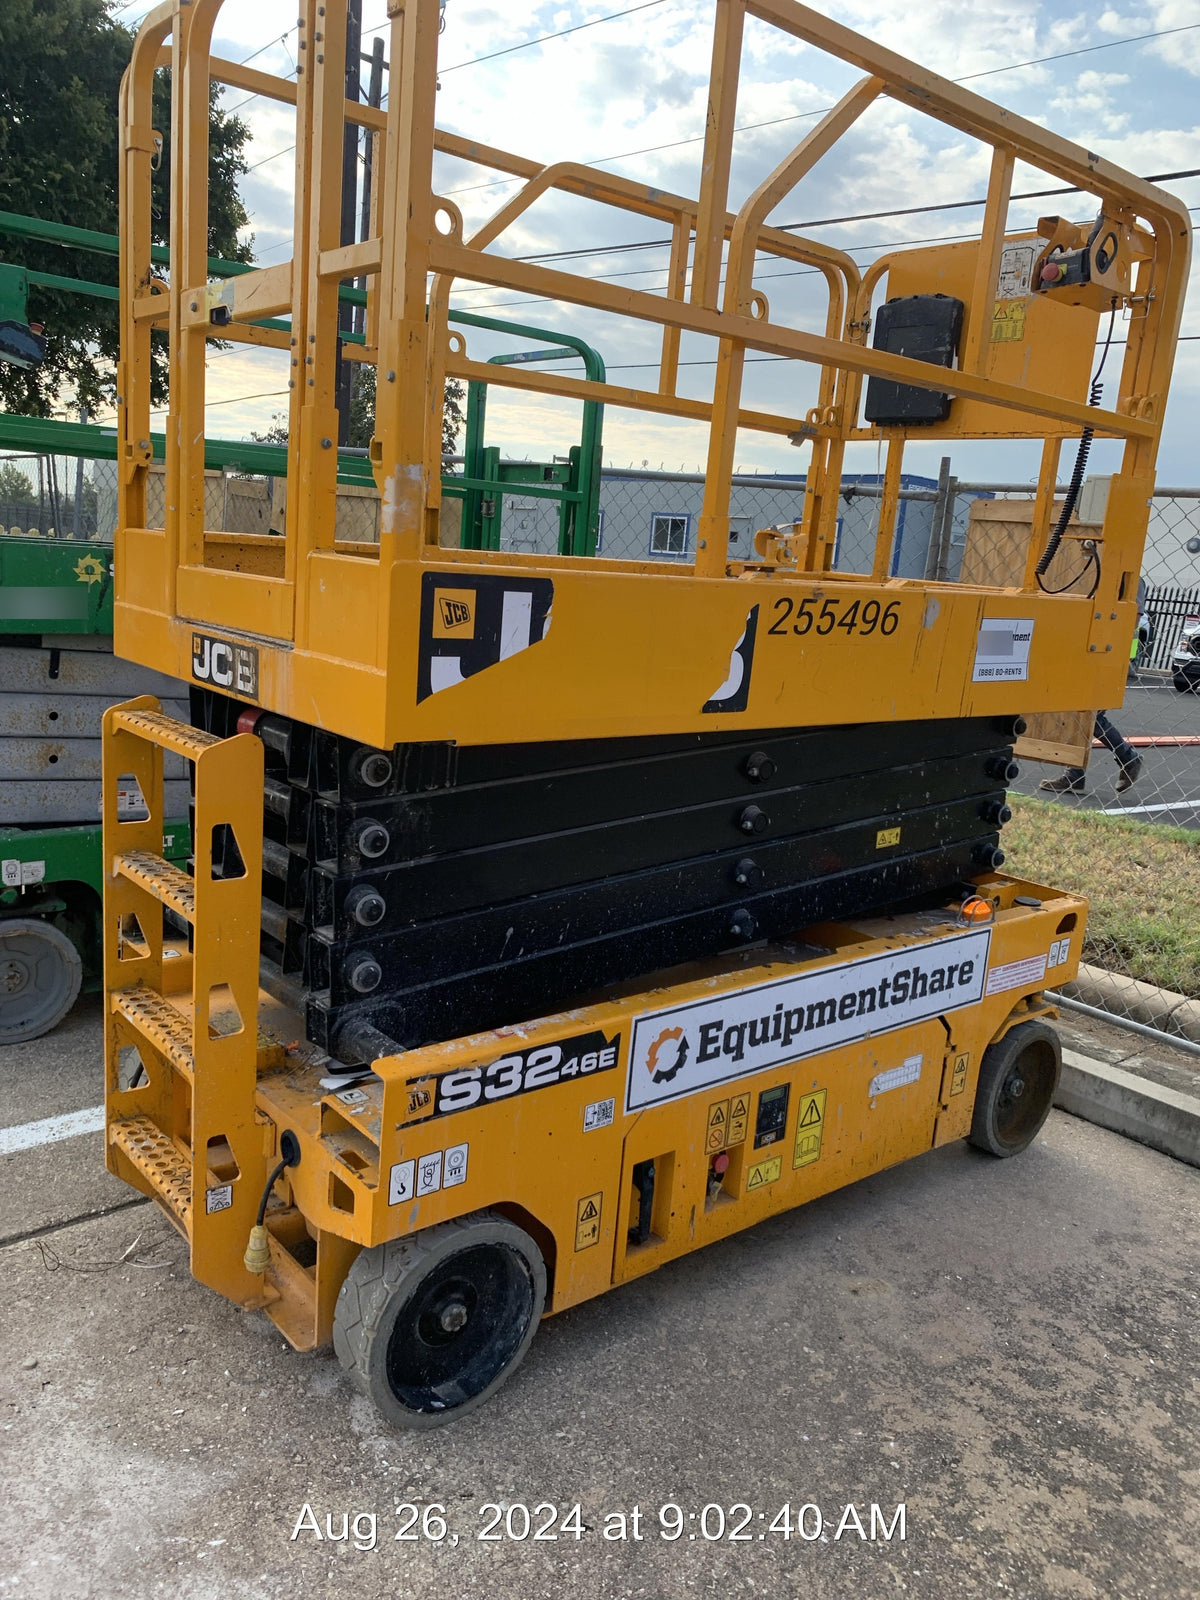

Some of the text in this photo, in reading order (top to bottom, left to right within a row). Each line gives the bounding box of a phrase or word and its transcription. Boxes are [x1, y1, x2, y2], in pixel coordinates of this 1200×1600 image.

[444, 601, 469, 625] JCB
[767, 597, 901, 636] 255496
[193, 639, 257, 694] JCB
[695, 959, 975, 1064] EquipmentShare
